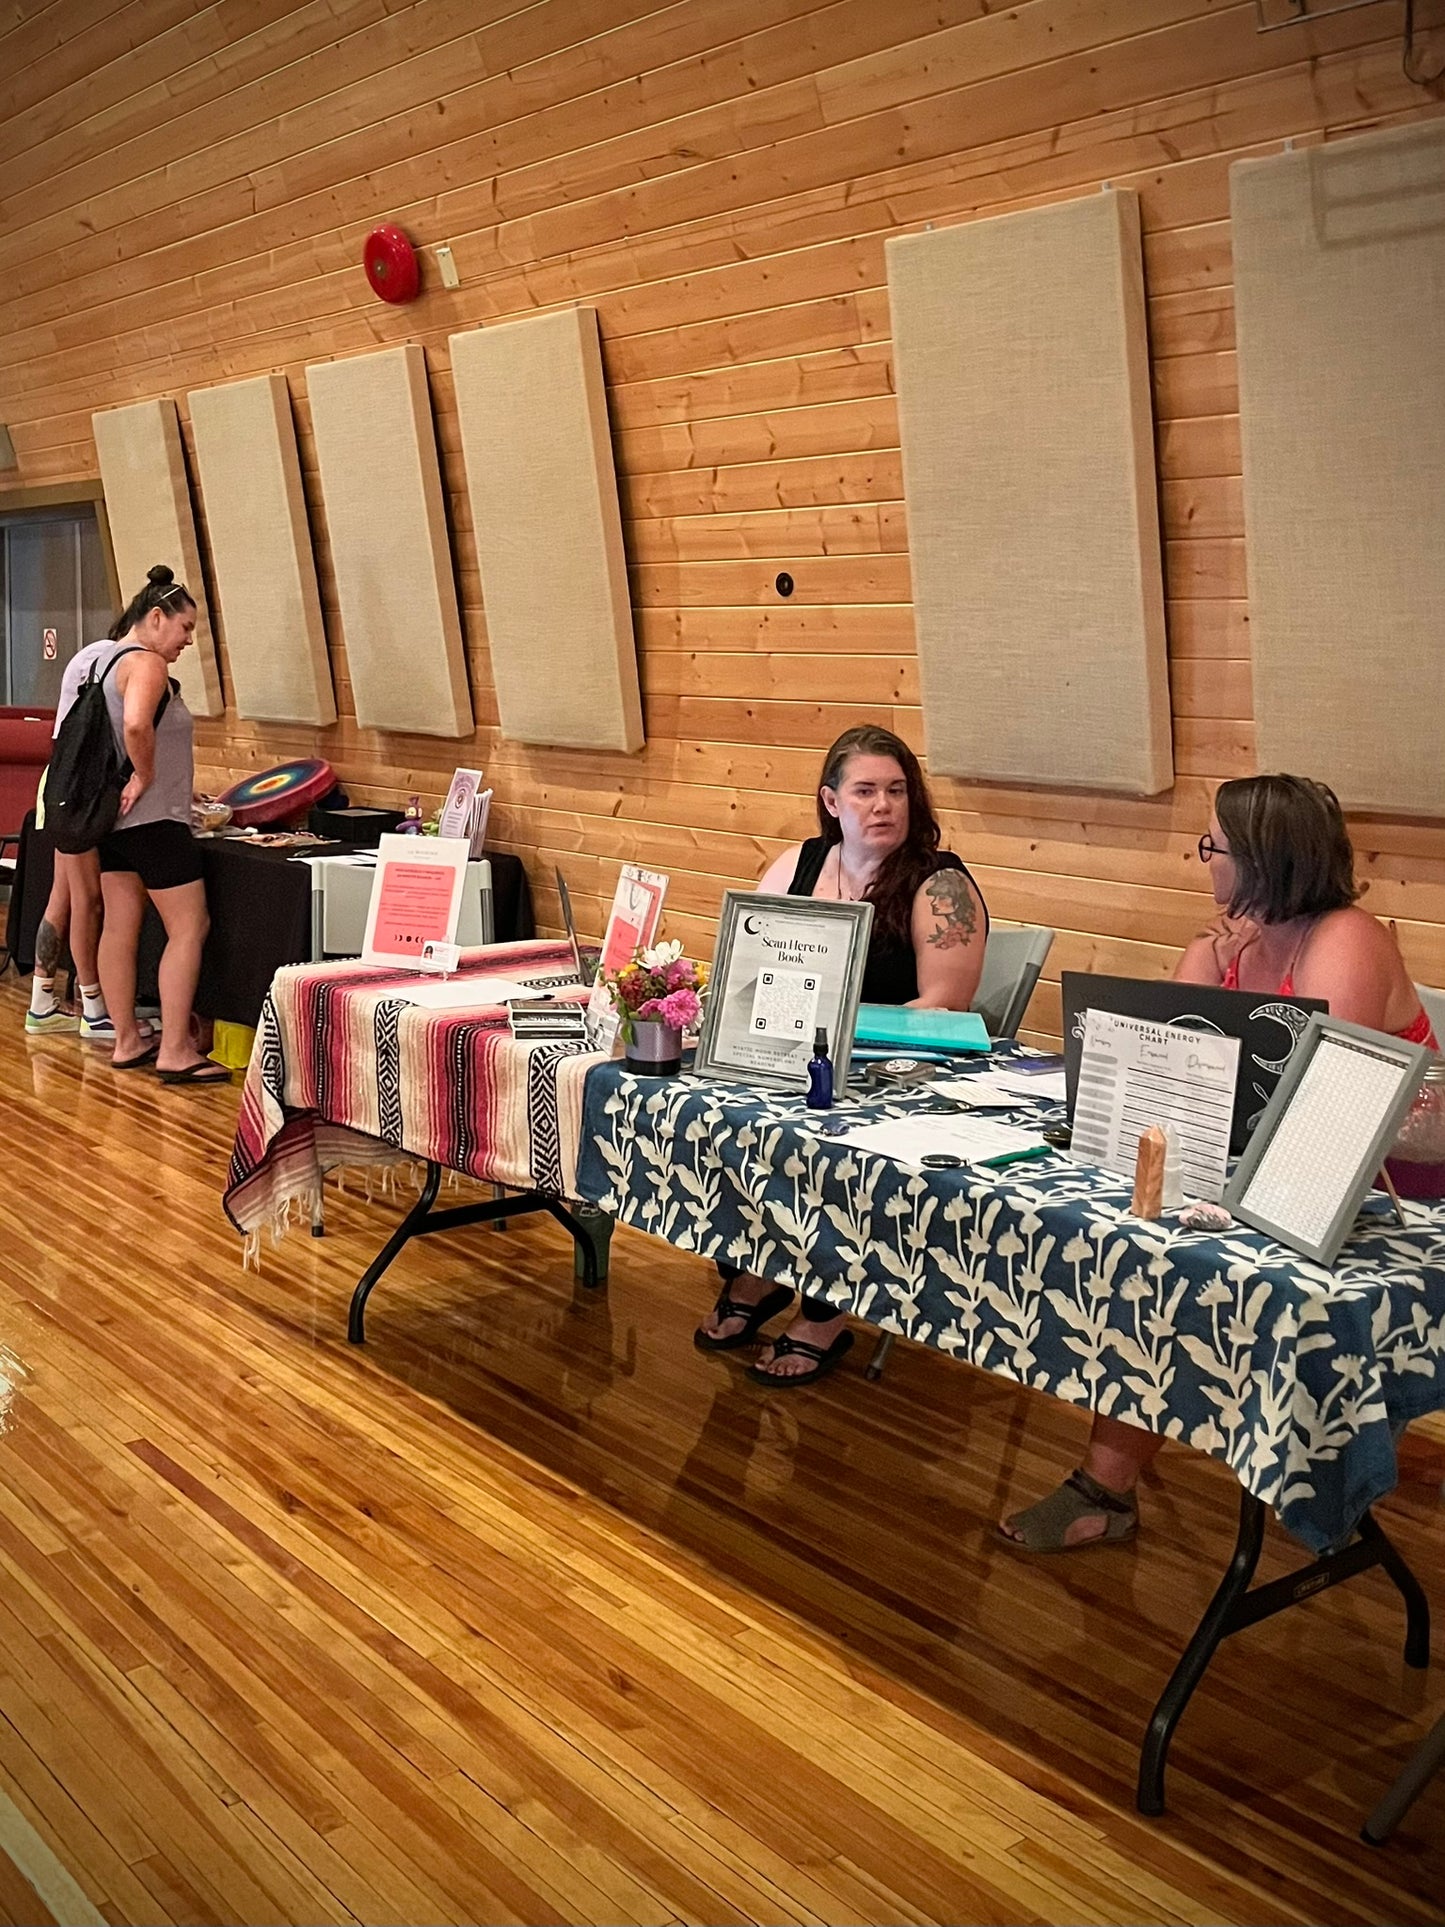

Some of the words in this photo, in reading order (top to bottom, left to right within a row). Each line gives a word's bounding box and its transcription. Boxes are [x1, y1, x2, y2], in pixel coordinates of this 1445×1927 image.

[761, 936, 787, 950] Scan
[789, 939, 816, 953] Here
[817, 944, 829, 954] to
[778, 950, 804, 964] Book
[1114, 1021, 1161, 1036] UNIVERSAL
[1165, 1031, 1201, 1044] ENERGY
[1139, 1034, 1168, 1045] CHART
